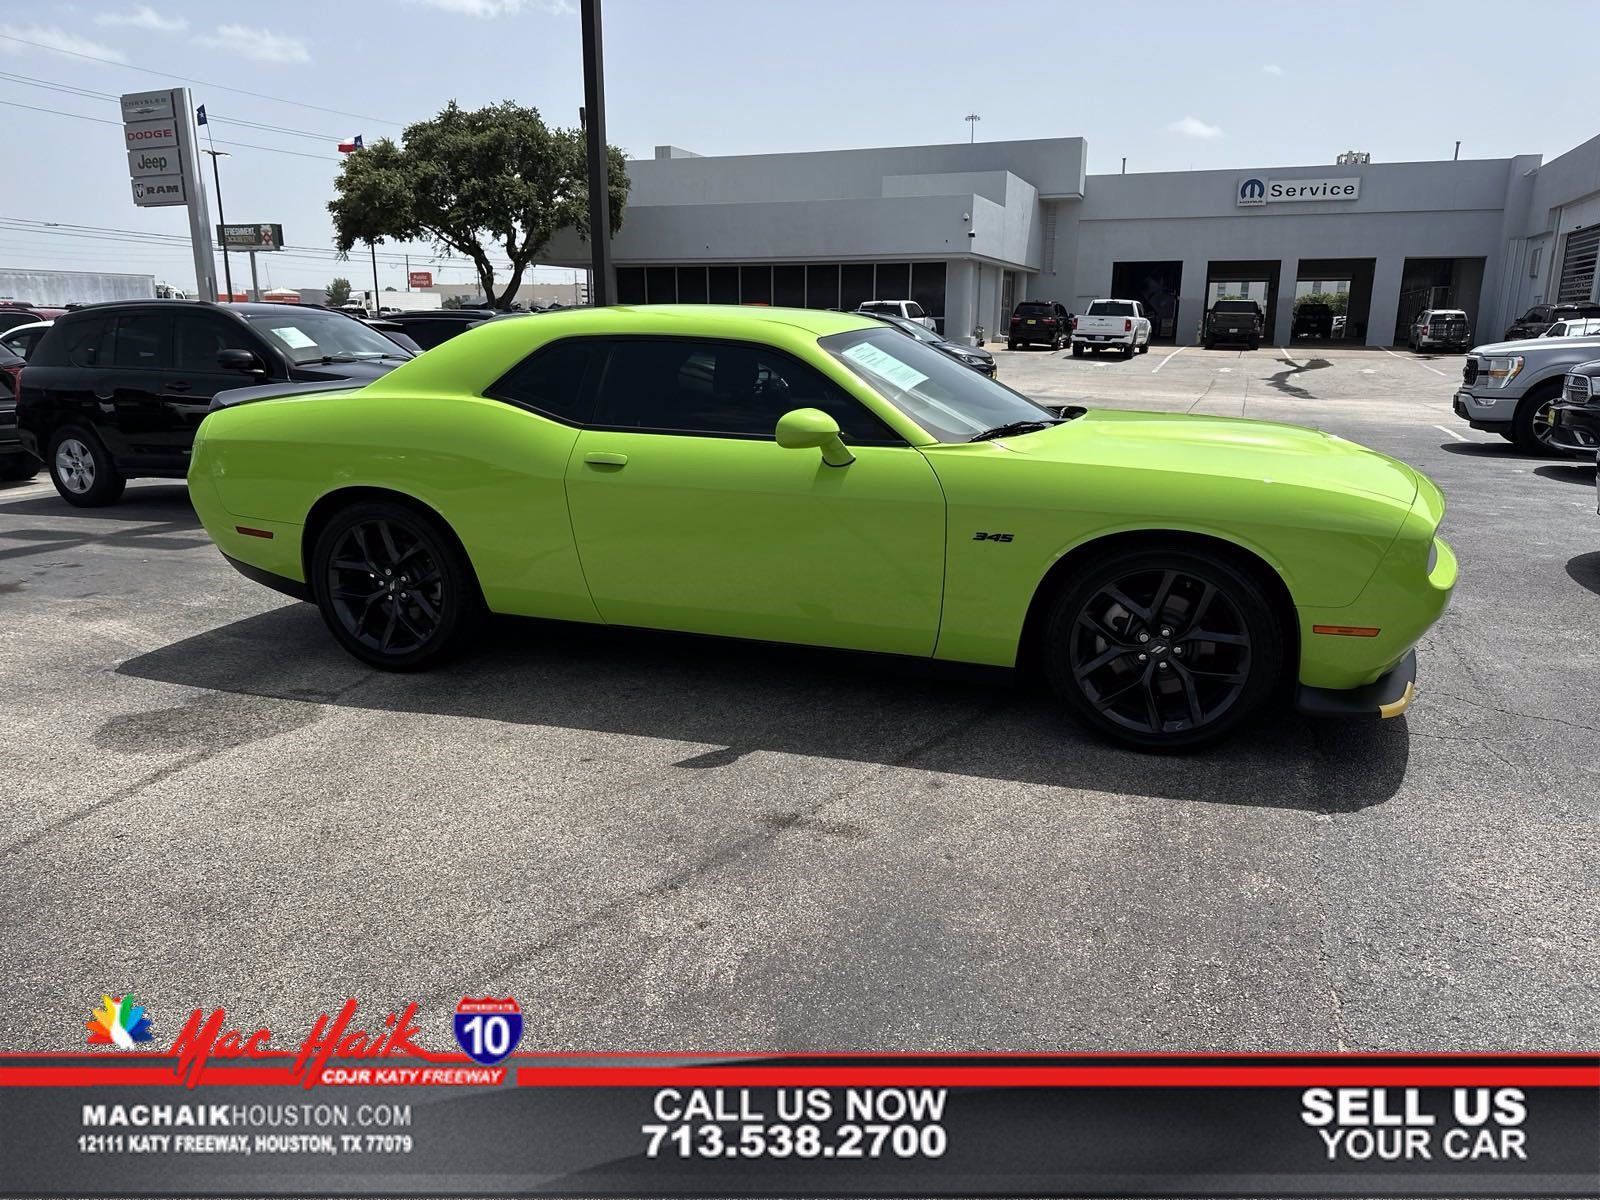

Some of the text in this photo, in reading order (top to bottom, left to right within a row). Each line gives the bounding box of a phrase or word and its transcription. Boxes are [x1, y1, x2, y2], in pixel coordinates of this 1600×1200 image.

[127, 129, 173, 141] DODGE
[138, 154, 167, 171] Jeep
[147, 185, 179, 195] RAM
[1270, 183, 1355, 197] Service
[972, 532, 1015, 543] 345
